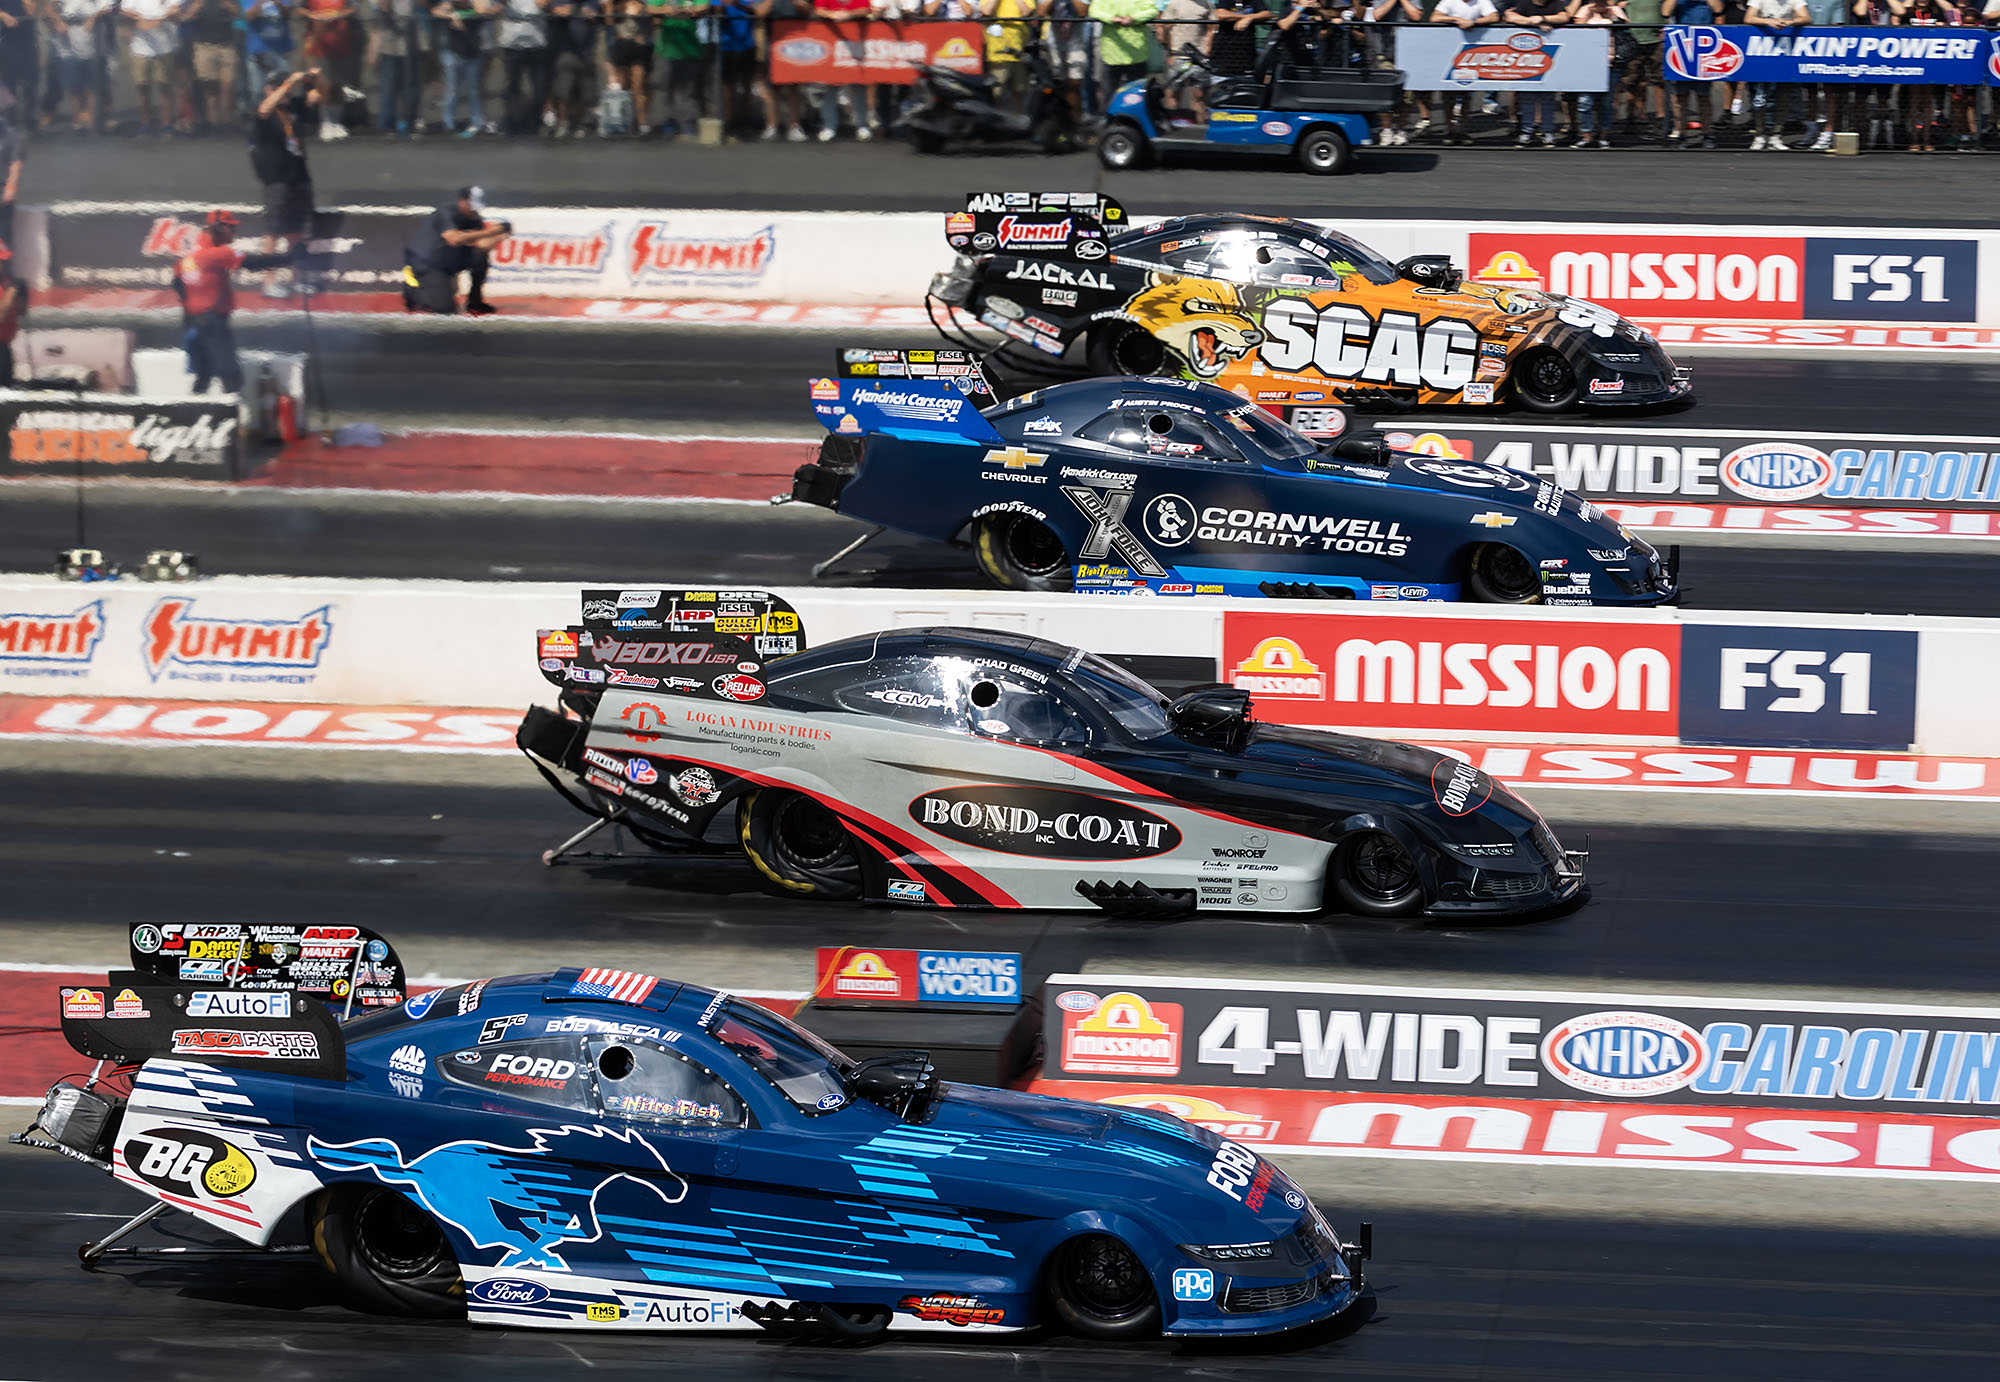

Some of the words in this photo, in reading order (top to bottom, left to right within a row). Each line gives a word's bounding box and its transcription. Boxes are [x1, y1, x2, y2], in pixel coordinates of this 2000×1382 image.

[1746, 36, 1859, 57] MAKIN'
[1857, 37, 1980, 59] POWER!
[1798, 63, 1925, 76] VPRacingFuels.com
[1006, 260, 1116, 290] JACKAL
[1283, 275, 1311, 284] SIMPSON
[1550, 251, 1798, 303] MISSION
[1833, 253, 1950, 302] FS1
[1261, 299, 1478, 390] SCAG
[937, 351, 965, 360] JESEL
[1123, 400, 1159, 409] AUSTIN
[1161, 400, 1192, 411] PROCK
[1023, 421, 1063, 432] PEAK
[981, 471, 1049, 484] CHEVROLET
[1739, 453, 1822, 487] NHRA
[972, 500, 1047, 521] GOODYEAR
[1078, 492, 1113, 529] JOHN
[1111, 524, 1154, 570] FORCE
[1201, 507, 1407, 541] CORNWELL
[1197, 526, 1311, 548] QUALITY
[1322, 537, 1408, 557] TOOLS
[718, 603, 755, 612] JESEL
[717, 618, 759, 627] BULLET
[769, 616, 794, 626] TMS
[147, 601, 328, 668] SUMMIT
[618, 642, 710, 665] BOXO
[705, 654, 739, 664] USA
[973, 657, 1008, 671] CHAD
[1009, 664, 1049, 686] GREEN
[1334, 638, 1671, 713] MISSION
[1720, 647, 1878, 715] FS1
[727, 681, 744, 692] RED
[744, 683, 764, 695] LINE
[1235, 675, 1321, 695] MISSION
[686, 710, 738, 730] LOGAN
[741, 718, 833, 742] INDUSTRIES
[698, 726, 757, 743] Manufacturing
[756, 735, 779, 747] parts
[780, 737, 787, 746] &
[788, 738, 816, 751] bodies
[730, 743, 782, 759] logankc.com
[625, 786, 690, 824] GOODYEAR
[922, 797, 1169, 850] BOND-COAT
[1034, 832, 1056, 846] INC.
[1219, 848, 1261, 859] MONROE
[888, 891, 924, 901] CARRILLO
[1199, 897, 1232, 905] MOOG
[193, 926, 228, 937] XRP
[249, 925, 297, 935] WILSON
[254, 932, 301, 943] MANIFOLDS
[302, 928, 358, 940] ARP
[302, 948, 350, 958] MANLEY
[181, 961, 222, 971] CP
[290, 962, 350, 972] BULLET
[919, 955, 1018, 977] CAMPING
[180, 973, 222, 981] CARRILLO
[241, 979, 296, 989] GOODYEAR
[298, 980, 331, 988] JESEL
[836, 978, 899, 993] MISSION
[920, 974, 1018, 997] WORLD
[358, 989, 395, 998] LINCOLN
[67, 1004, 101, 1013] MISSION
[206, 992, 290, 1015] AutoFi
[545, 1018, 589, 1034] BOB
[596, 1021, 660, 1040] TASCA
[661, 1030, 684, 1043] III
[274, 1047, 318, 1058] .COM
[390, 1045, 426, 1064] MAC
[1073, 1036, 1170, 1058] MISSION
[1197, 1006, 1542, 1088] 4-WIDE
[1571, 1028, 1682, 1076] NHRA
[388, 1060, 426, 1076] TOOLS
[488, 1054, 577, 1080] FORD
[484, 1071, 568, 1090] PERFORMANCE
[621, 1094, 676, 1115] Nitro
[677, 1098, 726, 1121] Fish
[820, 1095, 843, 1109] Ford
[139, 1141, 215, 1183] BG
[1206, 1141, 1258, 1202] FORD
[487, 1280, 535, 1303] Ford
[1175, 1272, 1212, 1297] PPG
[590, 1305, 616, 1316] TMS
[919, 1296, 978, 1309] HOUSE
[645, 1301, 732, 1324] AutoFi
[921, 1307, 1006, 1324] SPEED
